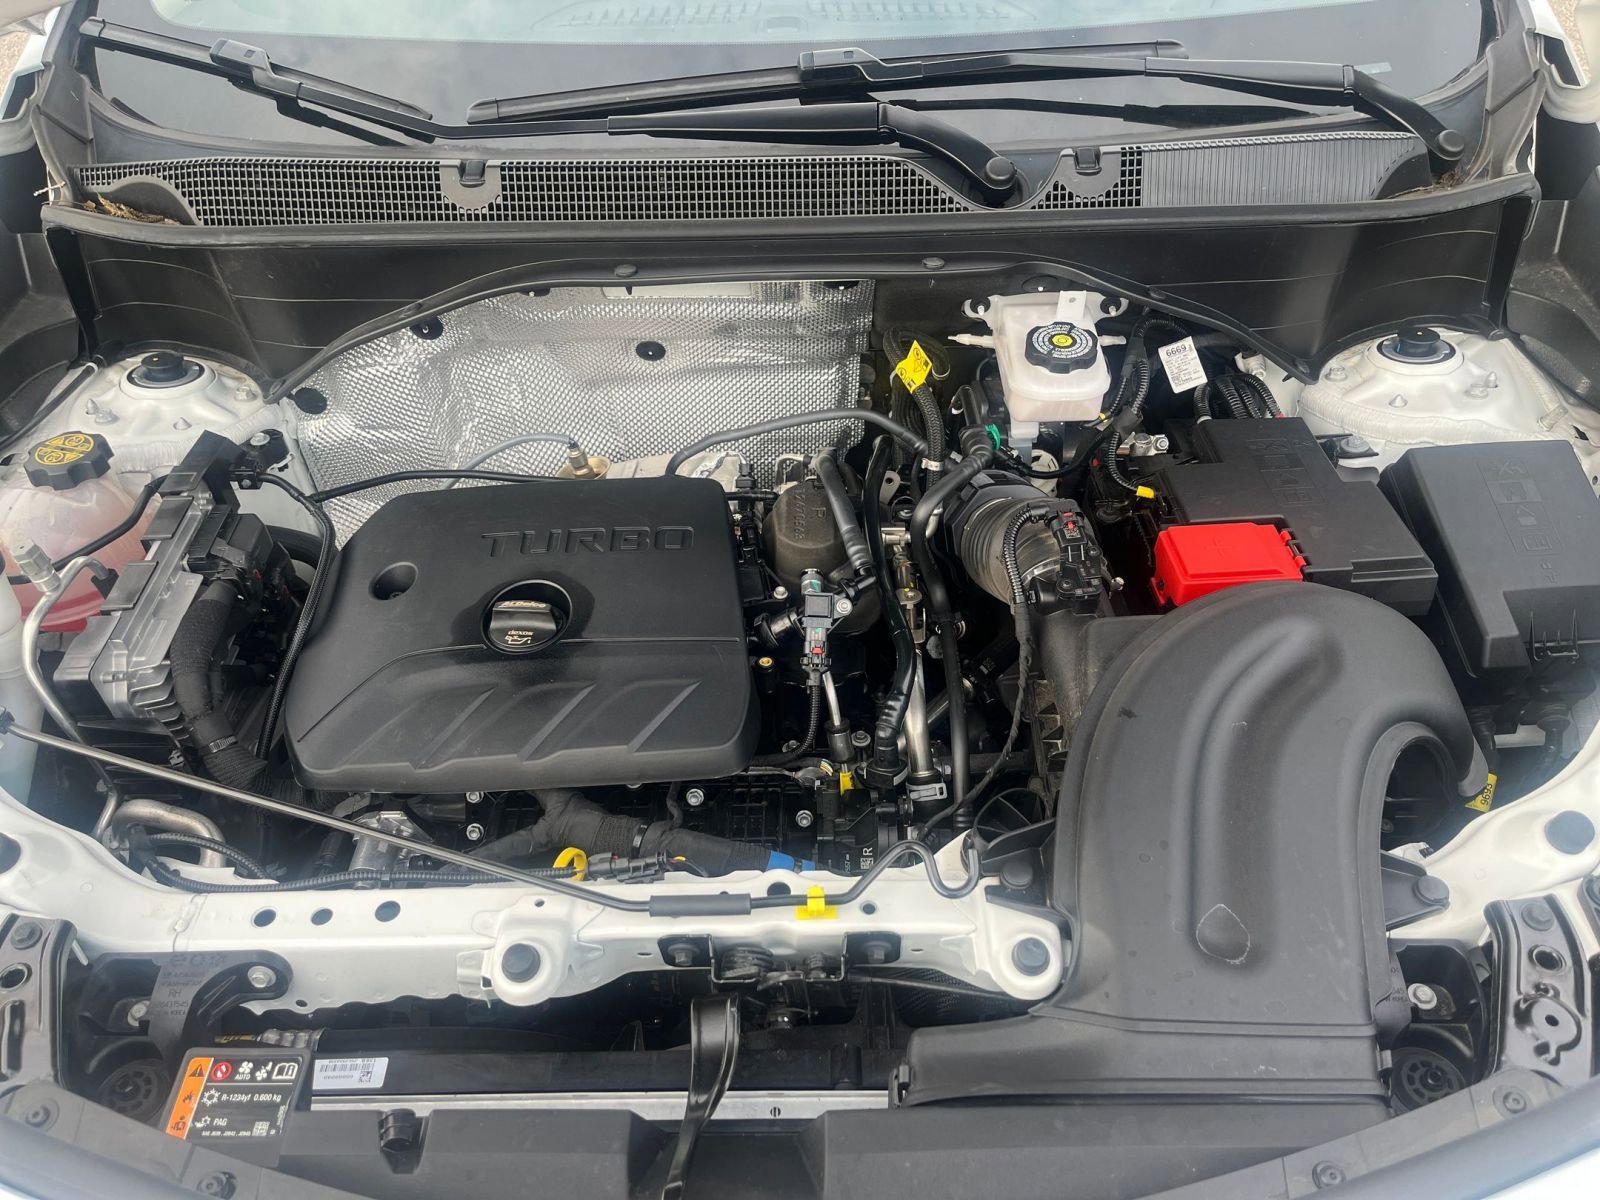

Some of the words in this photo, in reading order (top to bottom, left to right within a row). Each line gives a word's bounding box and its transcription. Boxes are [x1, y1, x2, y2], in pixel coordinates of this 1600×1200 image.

[1166, 344, 1187, 357] 6669
[481, 525, 695, 557] TURBO
[862, 847, 873, 856] R
[168, 988, 182, 998] RH
[234, 1073, 251, 1081] AUTO
[221, 1093, 250, 1103] R-1234yf
[273, 1094, 282, 1103] kg
[213, 1118, 228, 1126] PAG
